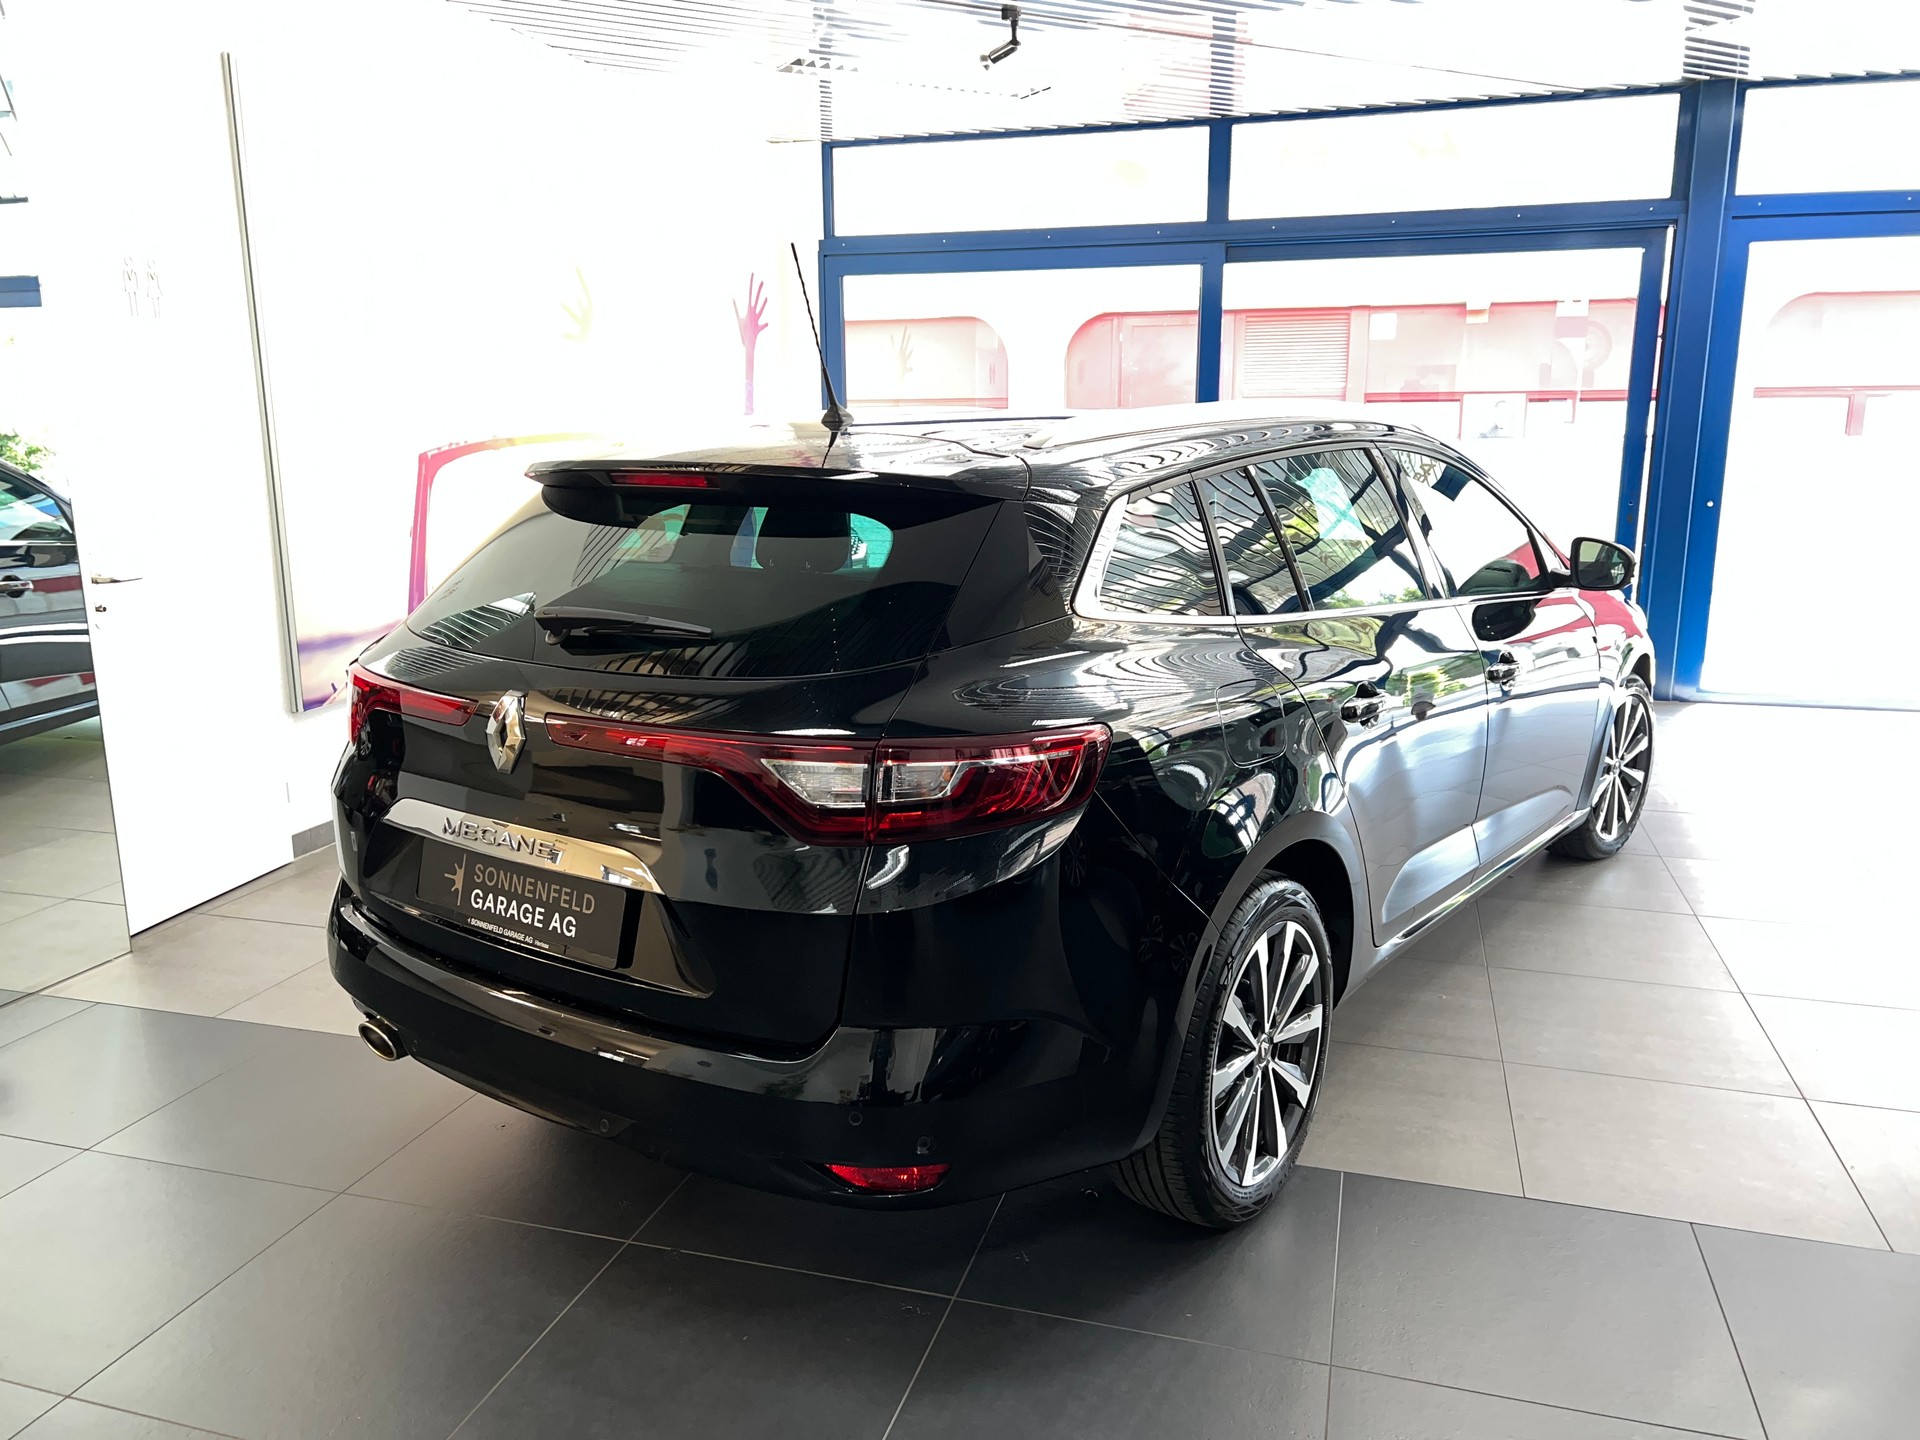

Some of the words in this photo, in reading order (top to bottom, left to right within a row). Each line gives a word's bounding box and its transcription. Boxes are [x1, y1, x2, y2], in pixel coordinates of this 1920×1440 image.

[442, 817, 556, 859] MEGANE
[474, 863, 595, 914] SONNENFELD
[470, 918, 503, 934] SONNENFELD
[503, 928, 525, 941] GARAGE
[525, 935, 534, 944] AG
[471, 889, 545, 928] GARAGE
[548, 912, 577, 938] AG
